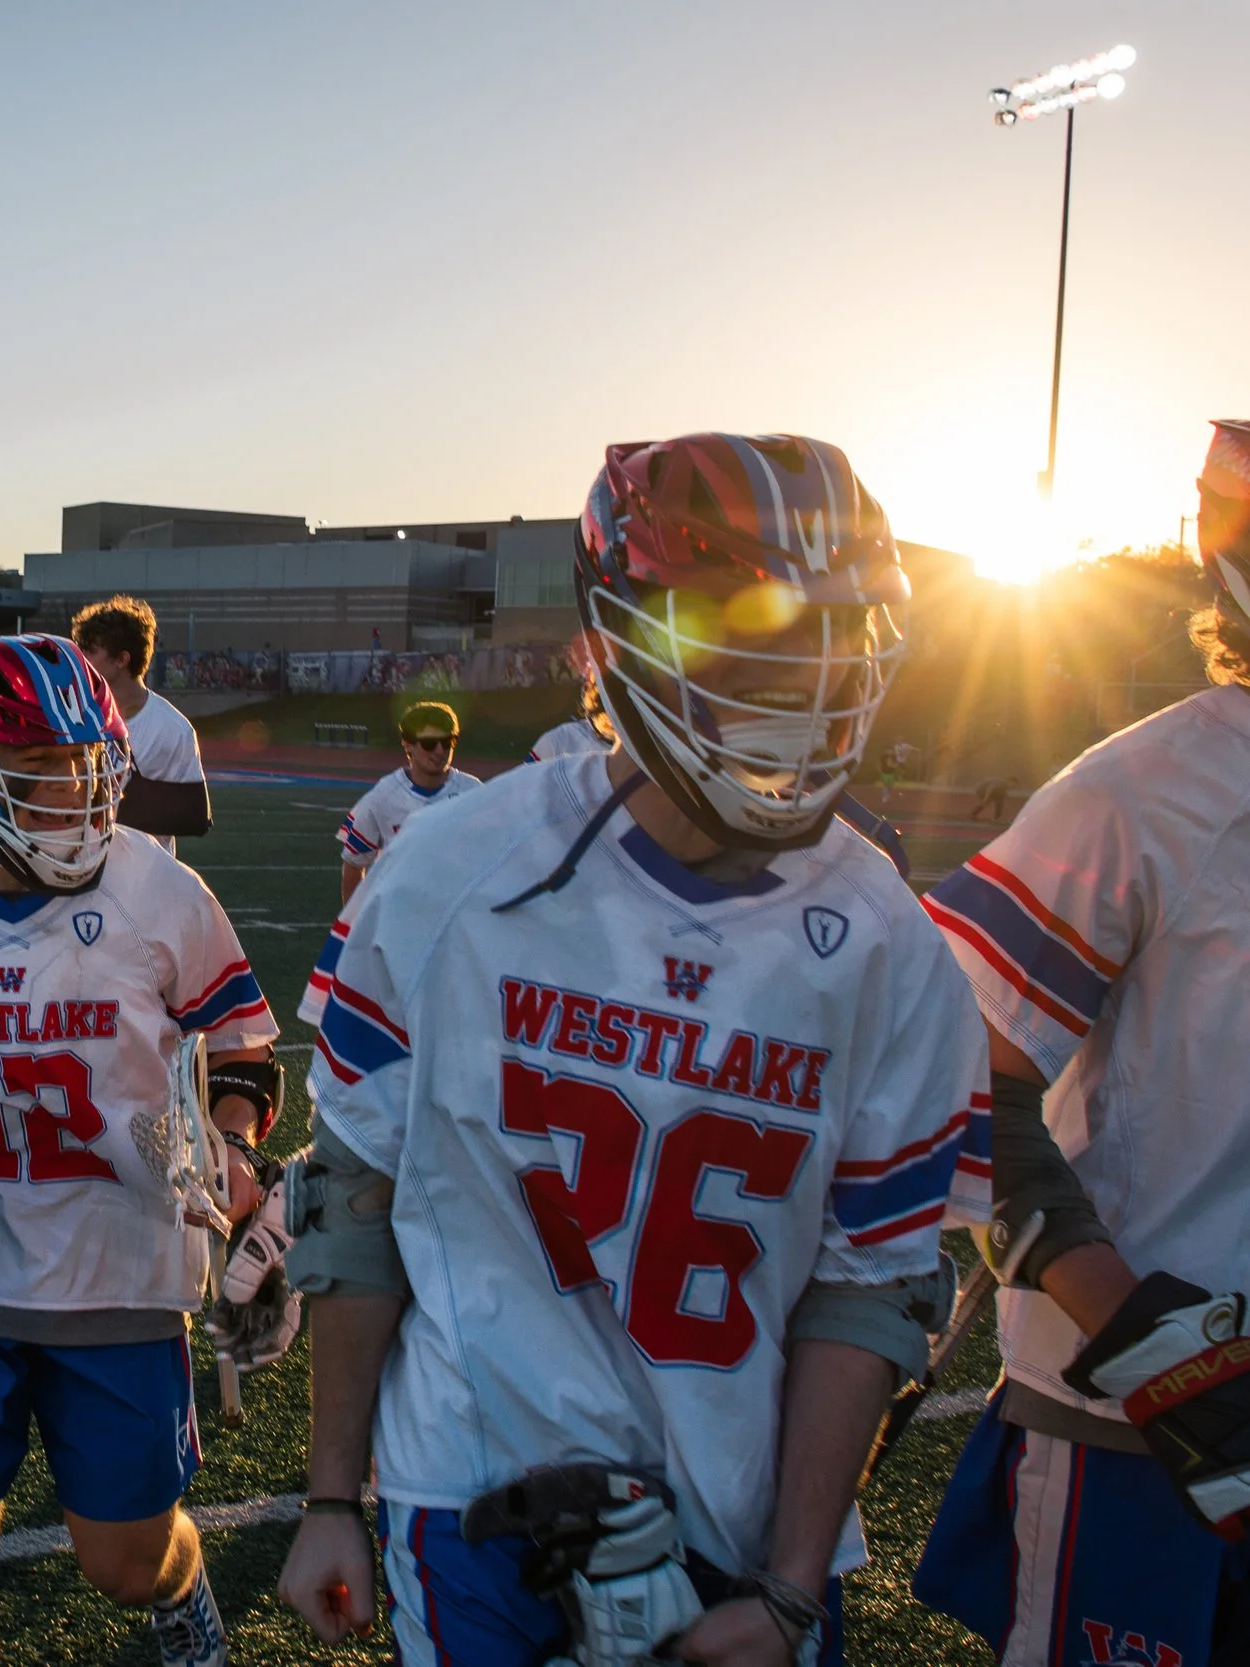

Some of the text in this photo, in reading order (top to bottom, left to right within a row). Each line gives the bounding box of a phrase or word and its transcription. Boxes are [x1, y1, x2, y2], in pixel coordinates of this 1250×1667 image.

[663, 956, 714, 1001] W
[208, 1075, 257, 1089] RMOUR
[499, 974, 832, 1115] WESTLAKE
[499, 1054, 816, 1374] 26
